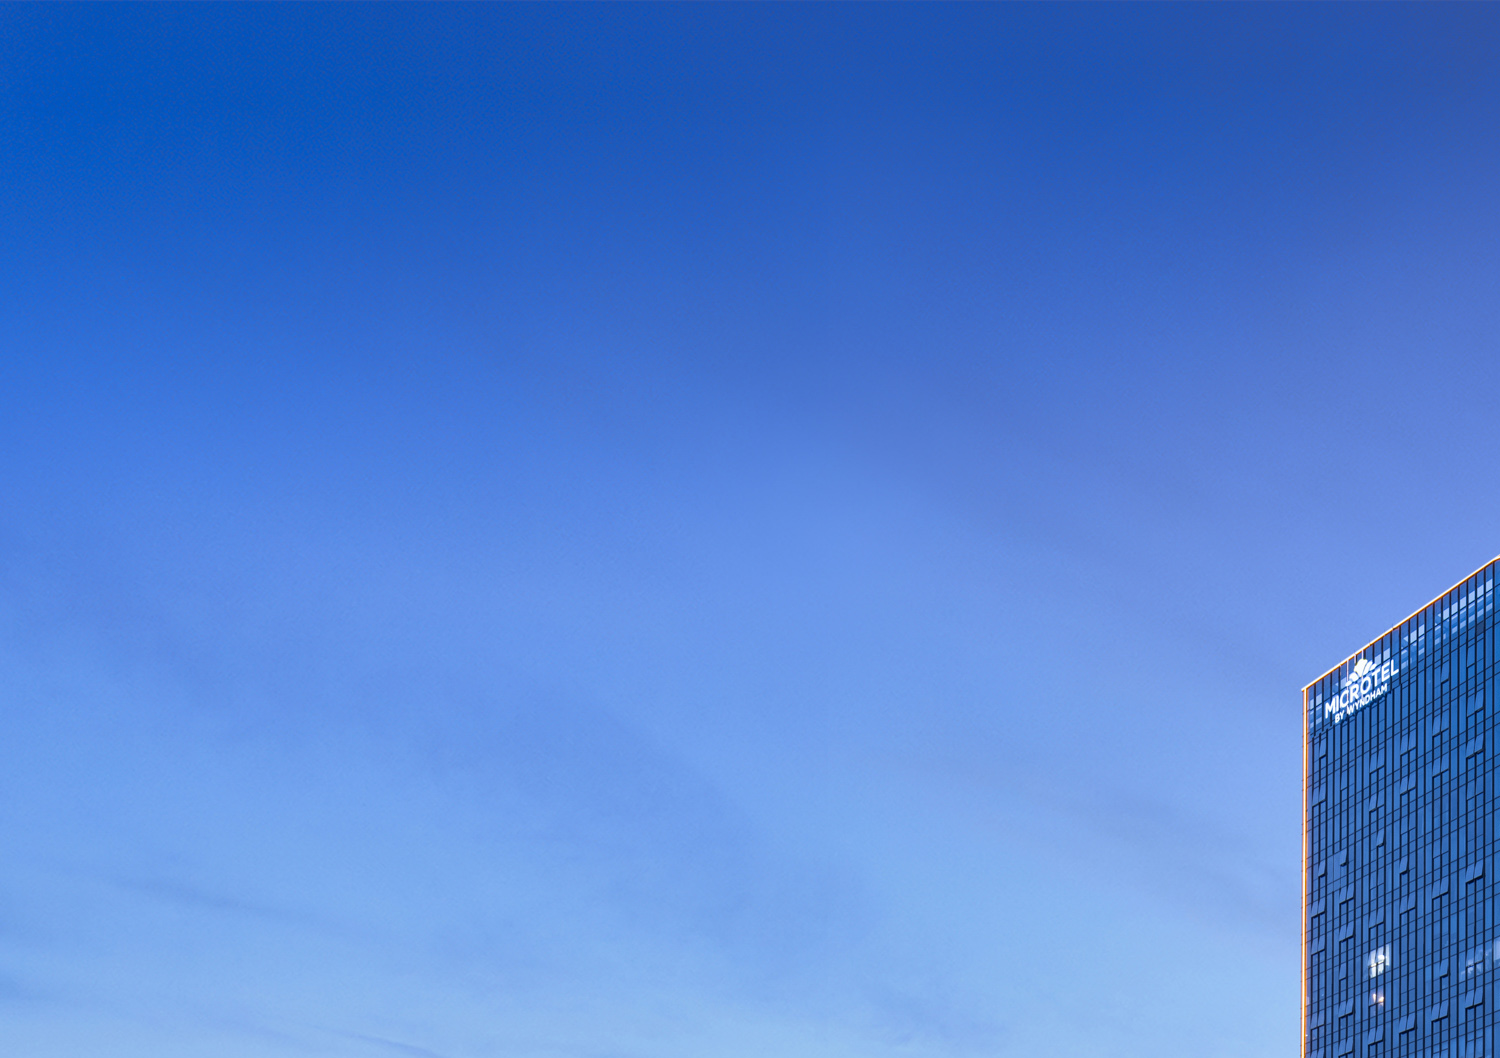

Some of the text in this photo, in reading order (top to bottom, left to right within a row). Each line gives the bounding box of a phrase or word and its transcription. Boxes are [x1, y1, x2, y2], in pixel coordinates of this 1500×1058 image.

[1325, 659, 1399, 719] MICROTEL
[1335, 683, 1388, 724] BY WYNDHAM
